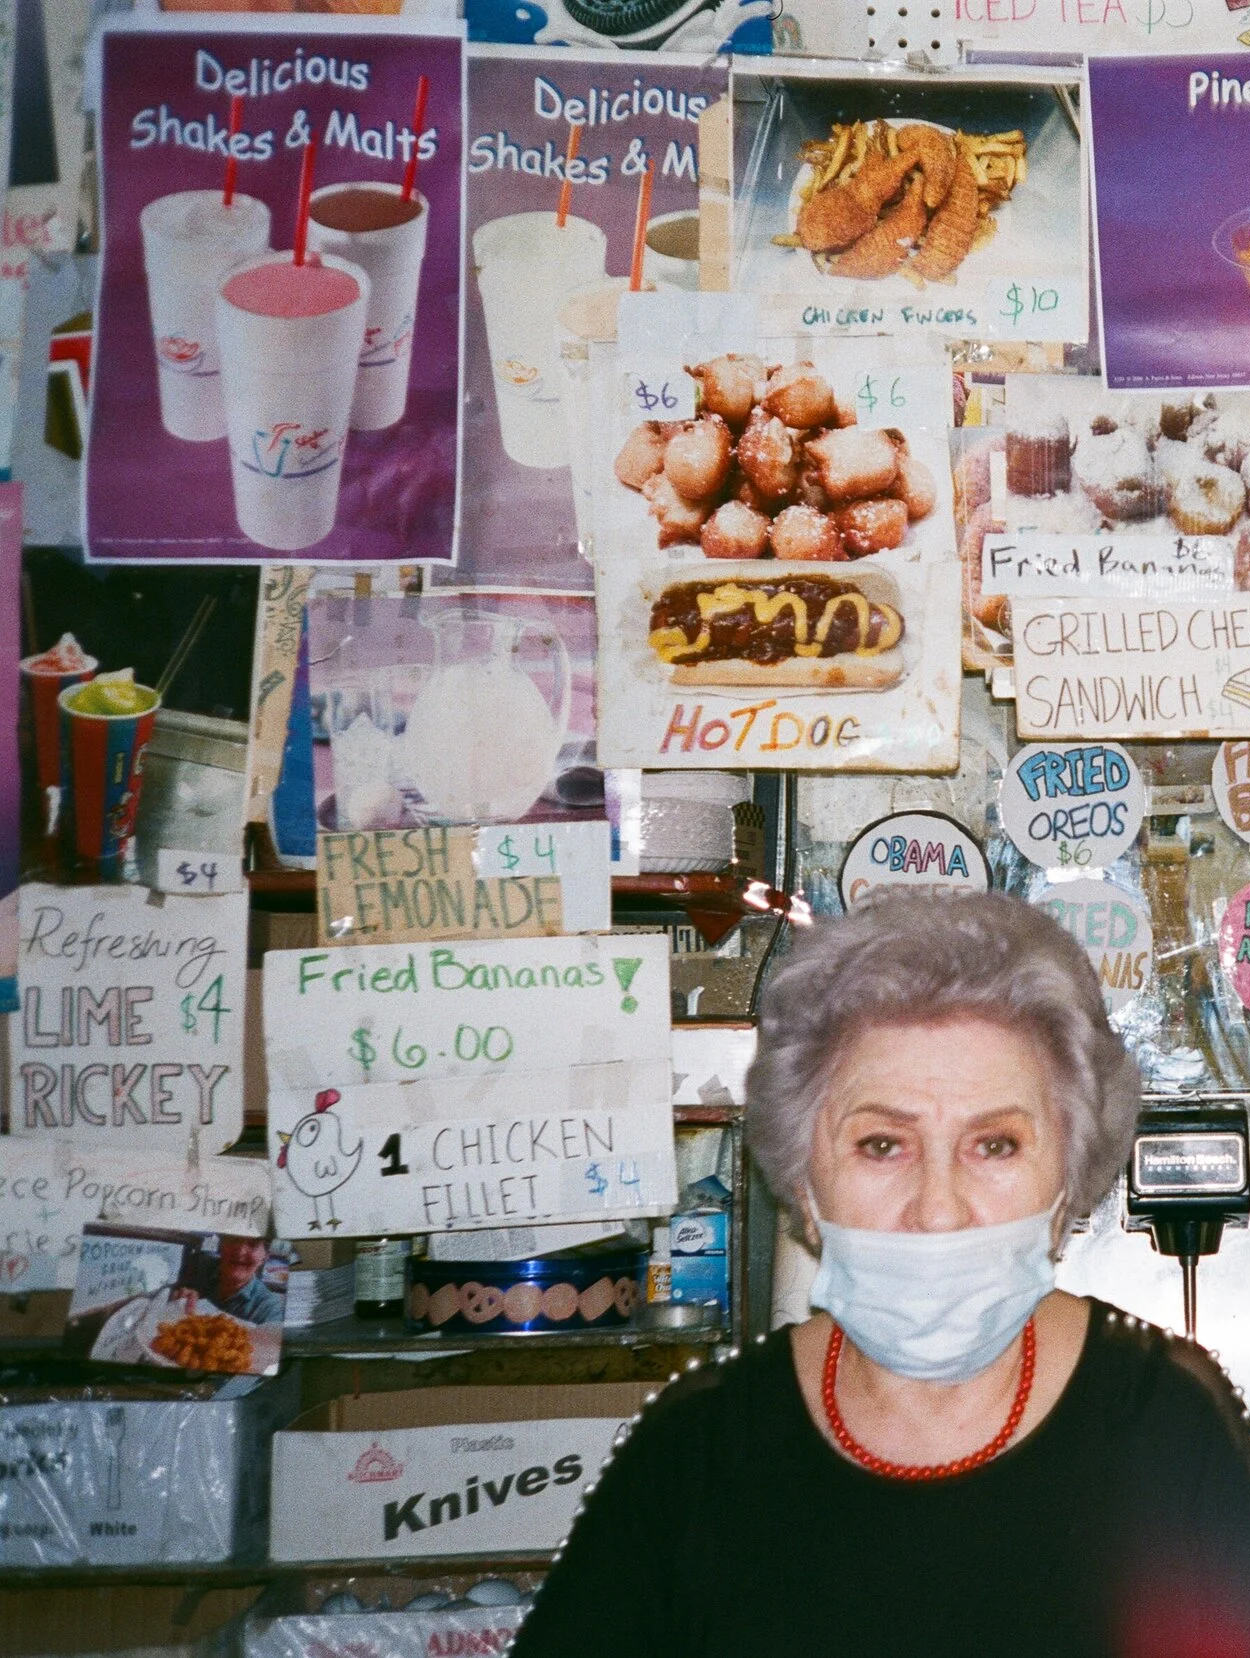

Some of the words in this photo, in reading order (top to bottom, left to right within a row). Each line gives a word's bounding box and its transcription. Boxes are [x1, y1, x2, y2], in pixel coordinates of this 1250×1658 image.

[195, 48, 369, 97] Delicious
[534, 76, 707, 126] Delicious
[129, 104, 275, 161] Shakes
[285, 109, 312, 148] &
[324, 109, 438, 162] Malts
[467, 131, 609, 185] Shakes
[620, 138, 648, 176] &
[802, 306, 885, 328] CHICKEN
[1000, 282, 1059, 326] $10
[635, 382, 678, 411] $6
[858, 374, 908, 409] $6
[990, 545, 1081, 579] Fried
[1022, 609, 1179, 657] GRILLED
[1025, 673, 1203, 730] SANDWICH
[758, 710, 862, 752] DOG
[1016, 745, 1131, 801] FRIED
[1028, 801, 1129, 842] OREOS
[175, 861, 219, 890] $4
[321, 824, 450, 882] FRESH
[496, 834, 556, 875] $4
[870, 834, 970, 878] OBAMA
[1058, 839, 1093, 867] $6
[20, 905, 229, 990] Refreshing
[299, 952, 419, 995] Fried
[23, 985, 155, 1049] LIME
[179, 973, 232, 1045] $4
[347, 1022, 514, 1072] $6.00
[19, 1060, 232, 1129] RICKEY
[377, 1133, 410, 1178] 1
[432, 1115, 614, 1171] CHICKEN
[1144, 1154, 1196, 1166] Hamilton
[65, 1167, 176, 1209] Popcorn
[185, 1183, 266, 1229] Shrimp
[421, 1173, 539, 1226] FILLET
[583, 1160, 642, 1208] $4
[383, 1453, 584, 1542] Knives
[89, 1521, 138, 1537] White
